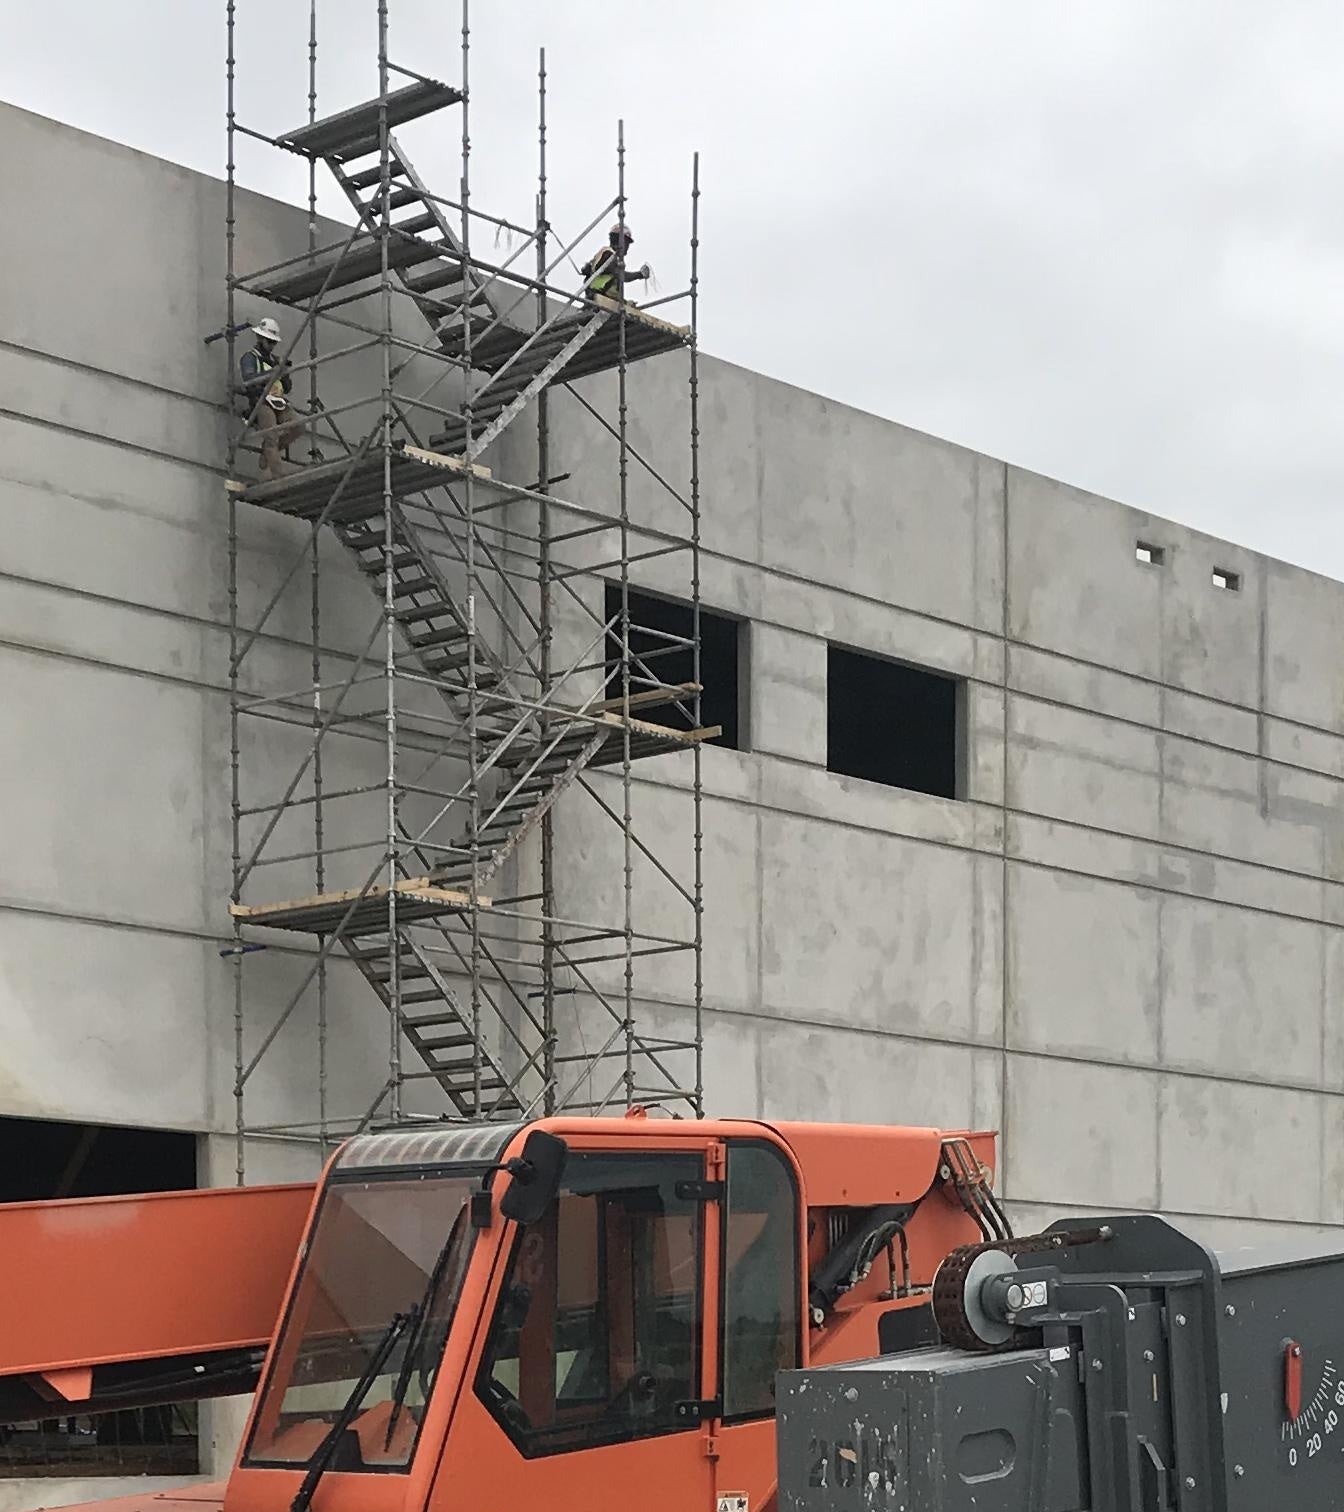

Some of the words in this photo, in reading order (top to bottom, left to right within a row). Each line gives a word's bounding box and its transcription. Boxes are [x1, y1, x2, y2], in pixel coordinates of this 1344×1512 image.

[1289, 1448, 1297, 1466] 0
[1306, 1432, 1322, 1458] 20
[1324, 1409, 1338, 1435] 40
